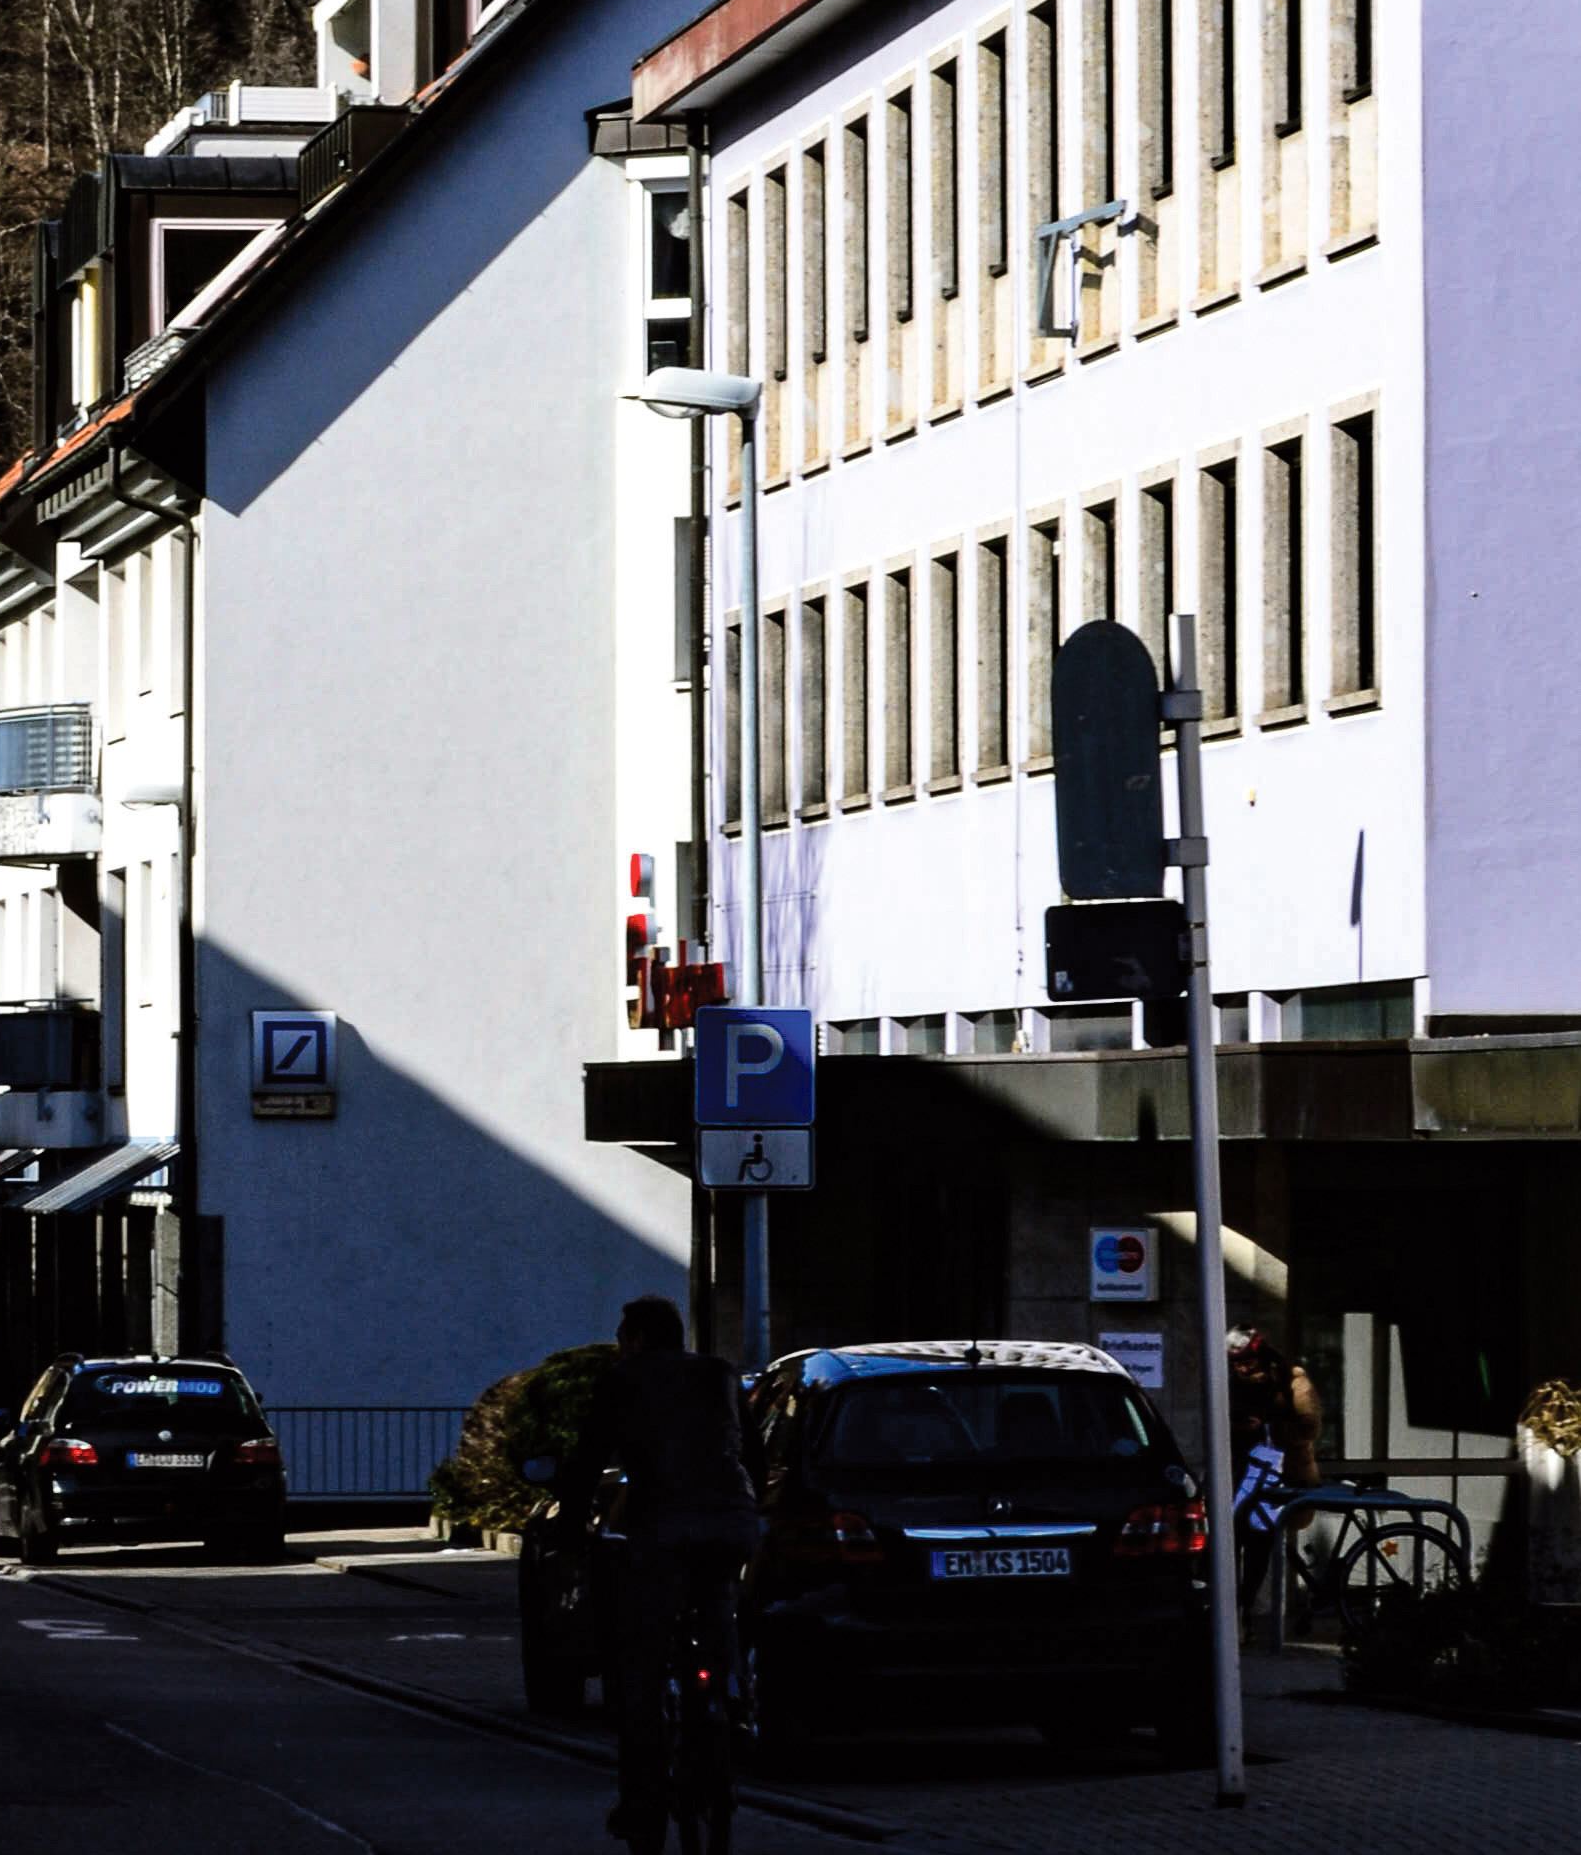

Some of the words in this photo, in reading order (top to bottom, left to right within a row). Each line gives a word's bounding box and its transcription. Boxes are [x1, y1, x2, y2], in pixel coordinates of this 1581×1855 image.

[725, 1024, 785, 1108] P
[945, 1553, 971, 1575] EM
[986, 1551, 1012, 1573] KS
[1018, 1550, 1067, 1572] 1504
